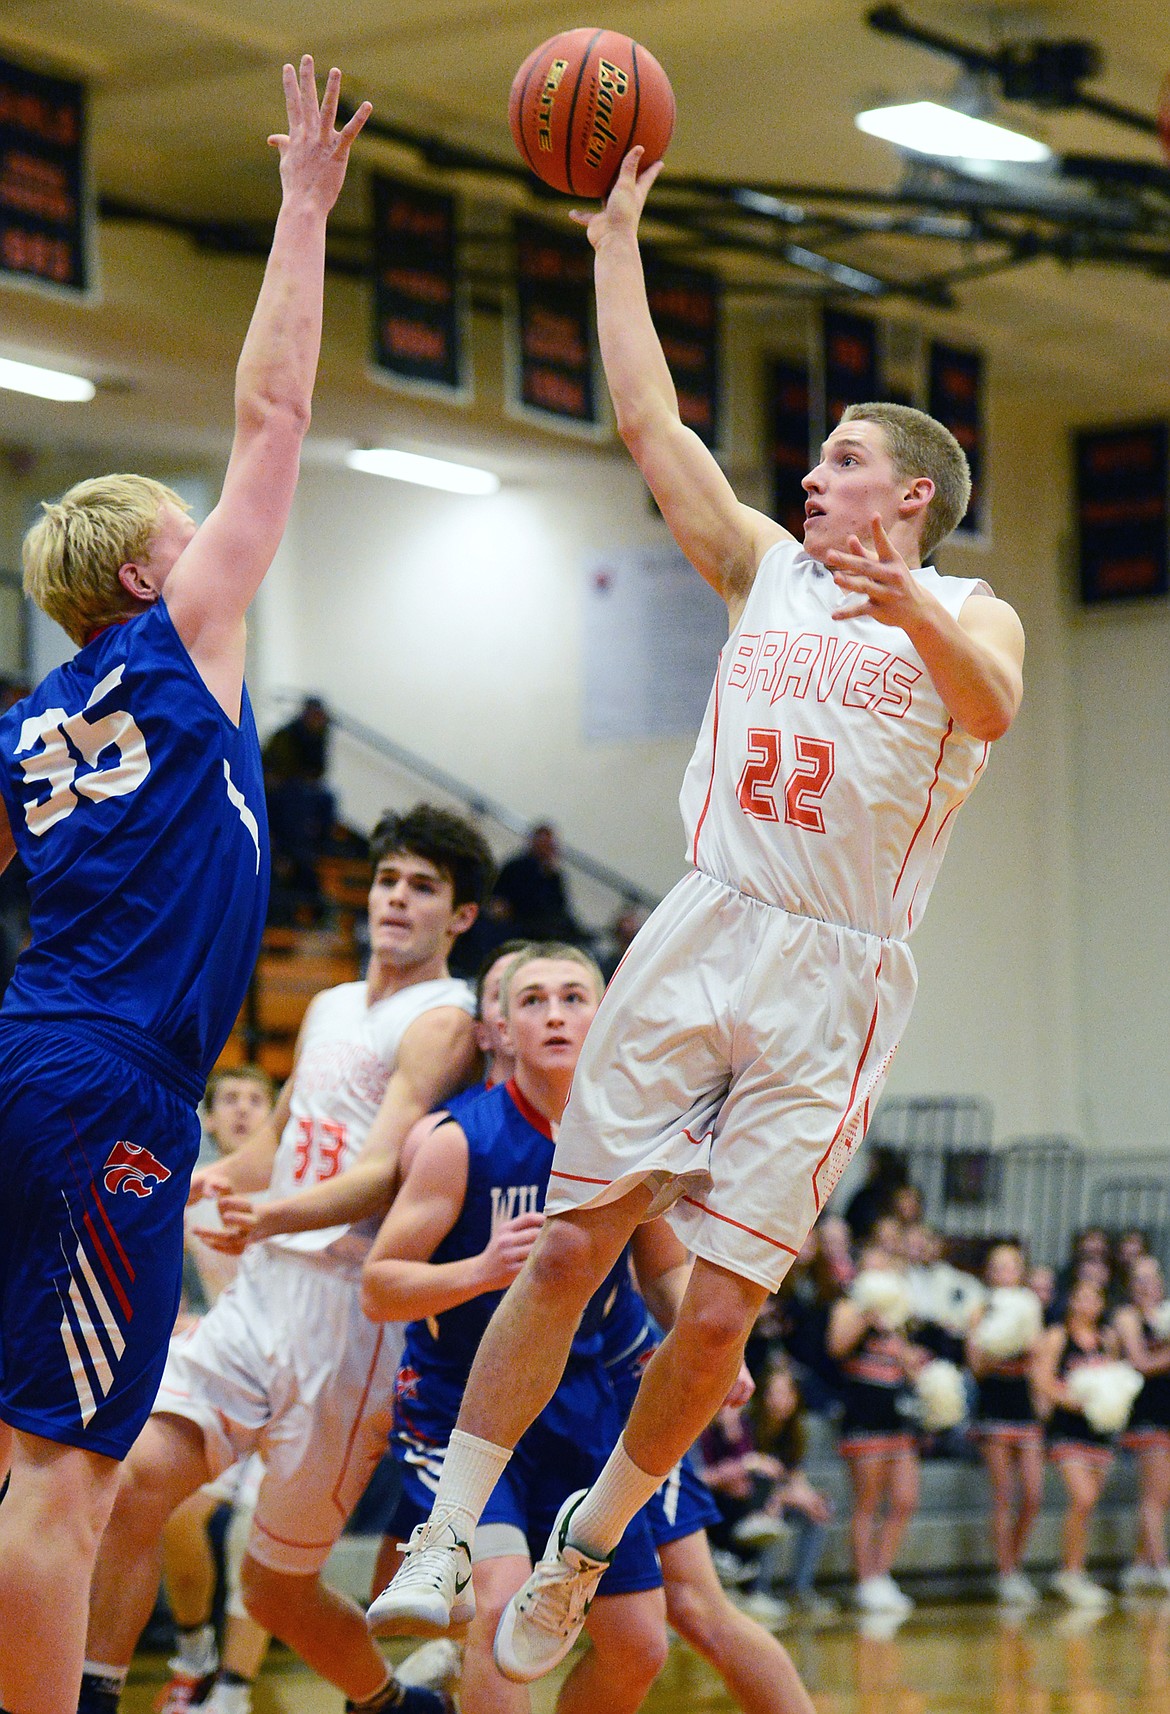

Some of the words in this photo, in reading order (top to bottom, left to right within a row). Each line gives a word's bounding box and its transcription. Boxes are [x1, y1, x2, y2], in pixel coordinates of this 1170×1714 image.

[585, 57, 629, 169] Baden
[727, 630, 924, 719] BRAVES
[13, 663, 151, 837] 35
[735, 727, 835, 835] 22
[292, 1115, 349, 1186] 33
